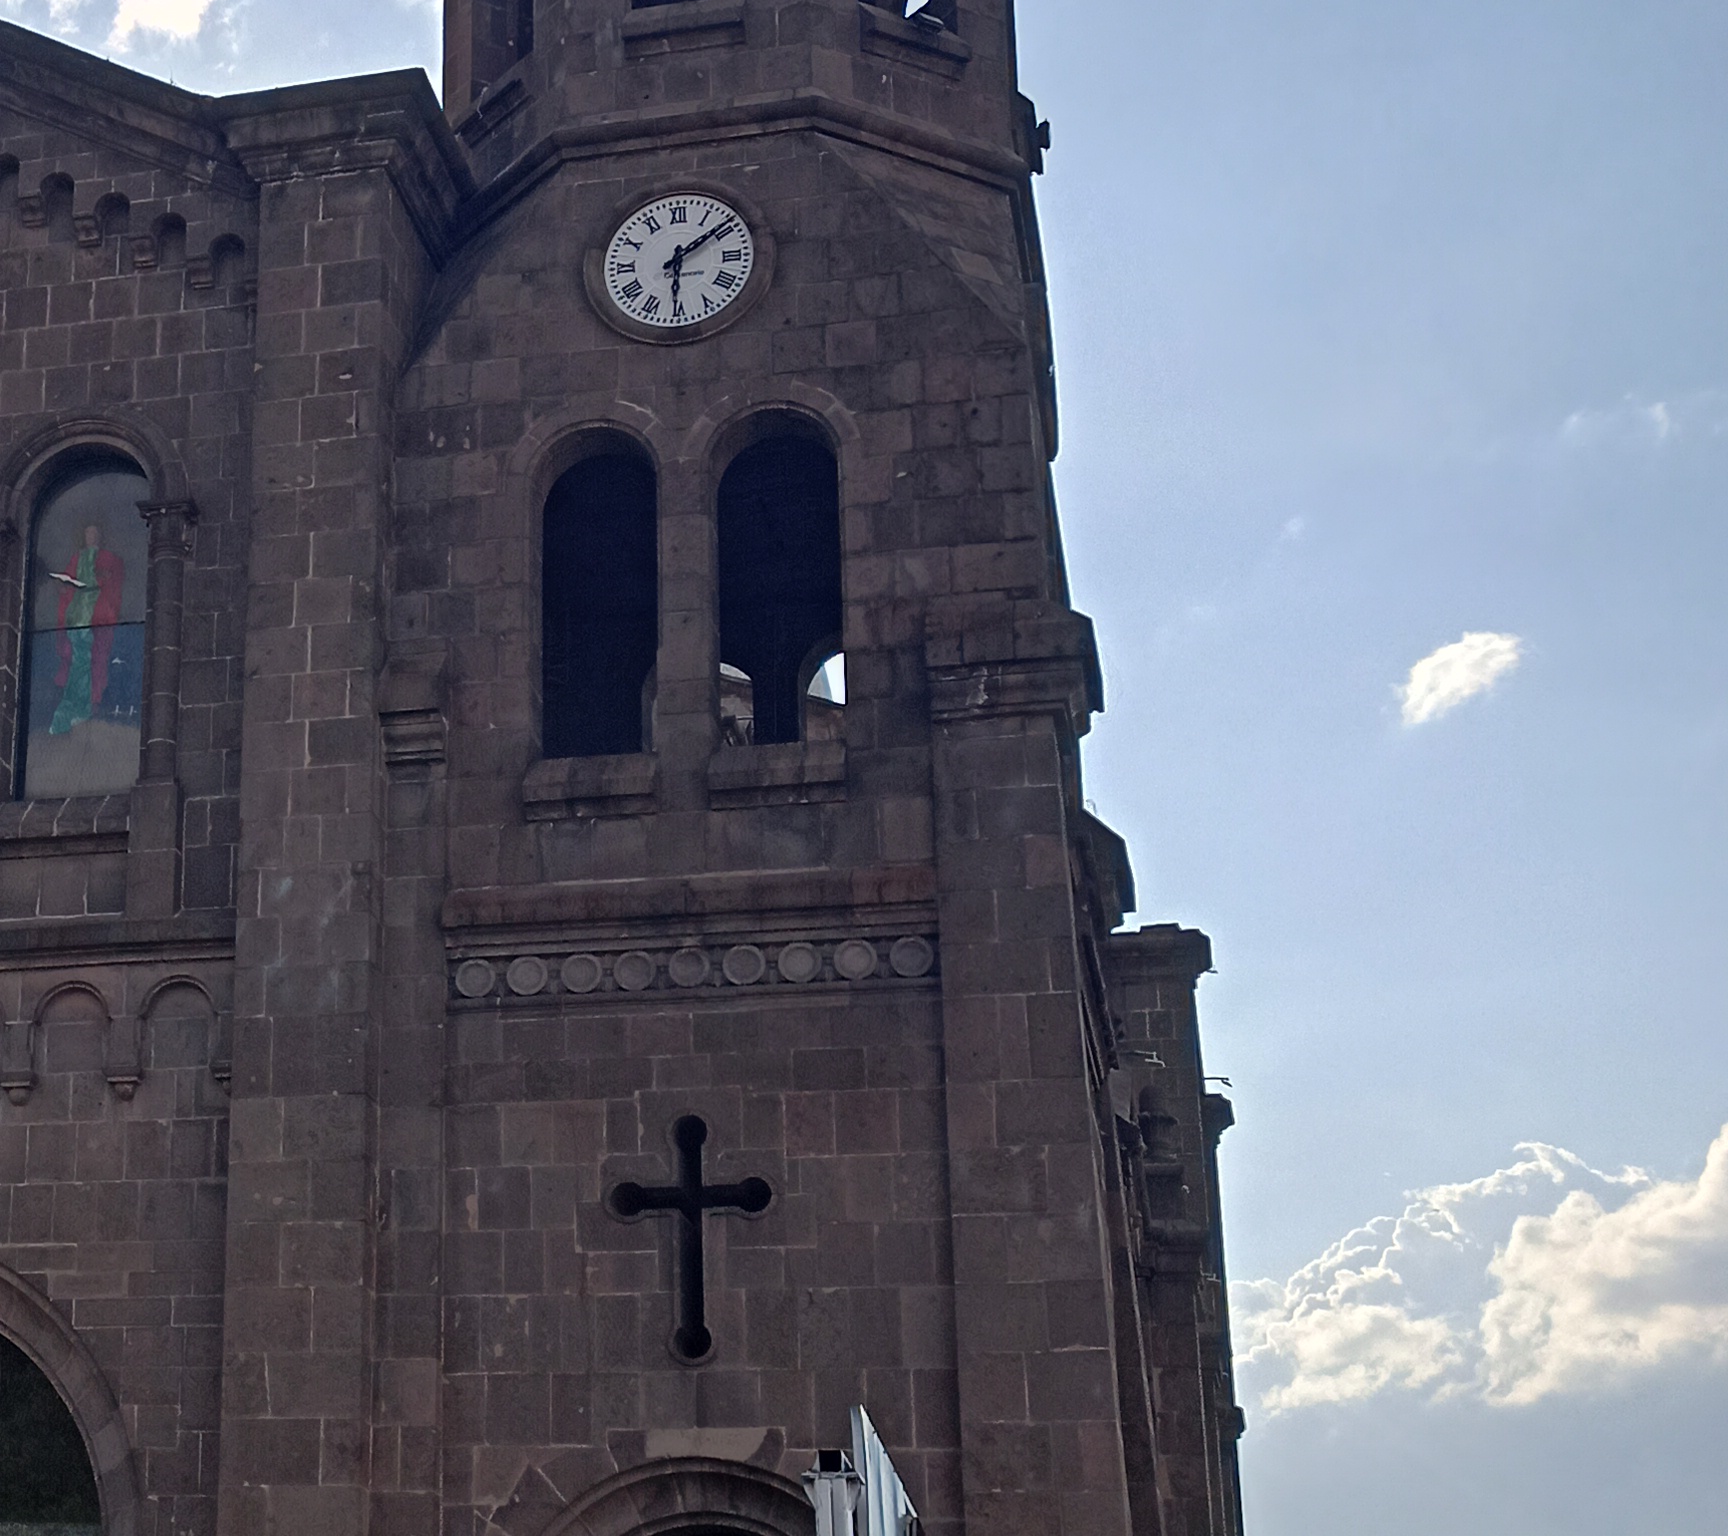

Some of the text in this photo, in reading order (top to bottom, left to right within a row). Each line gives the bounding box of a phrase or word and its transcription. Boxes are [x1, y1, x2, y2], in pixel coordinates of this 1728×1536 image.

[669, 206, 688, 225] XII
[642, 215, 662, 235] XI
[623, 237, 643, 252] X
[722, 249, 742, 264] III
[616, 260, 636, 275] IX
[622, 278, 643, 303] VIII
[642, 294, 661, 316] VII
[701, 294, 715, 311] V
